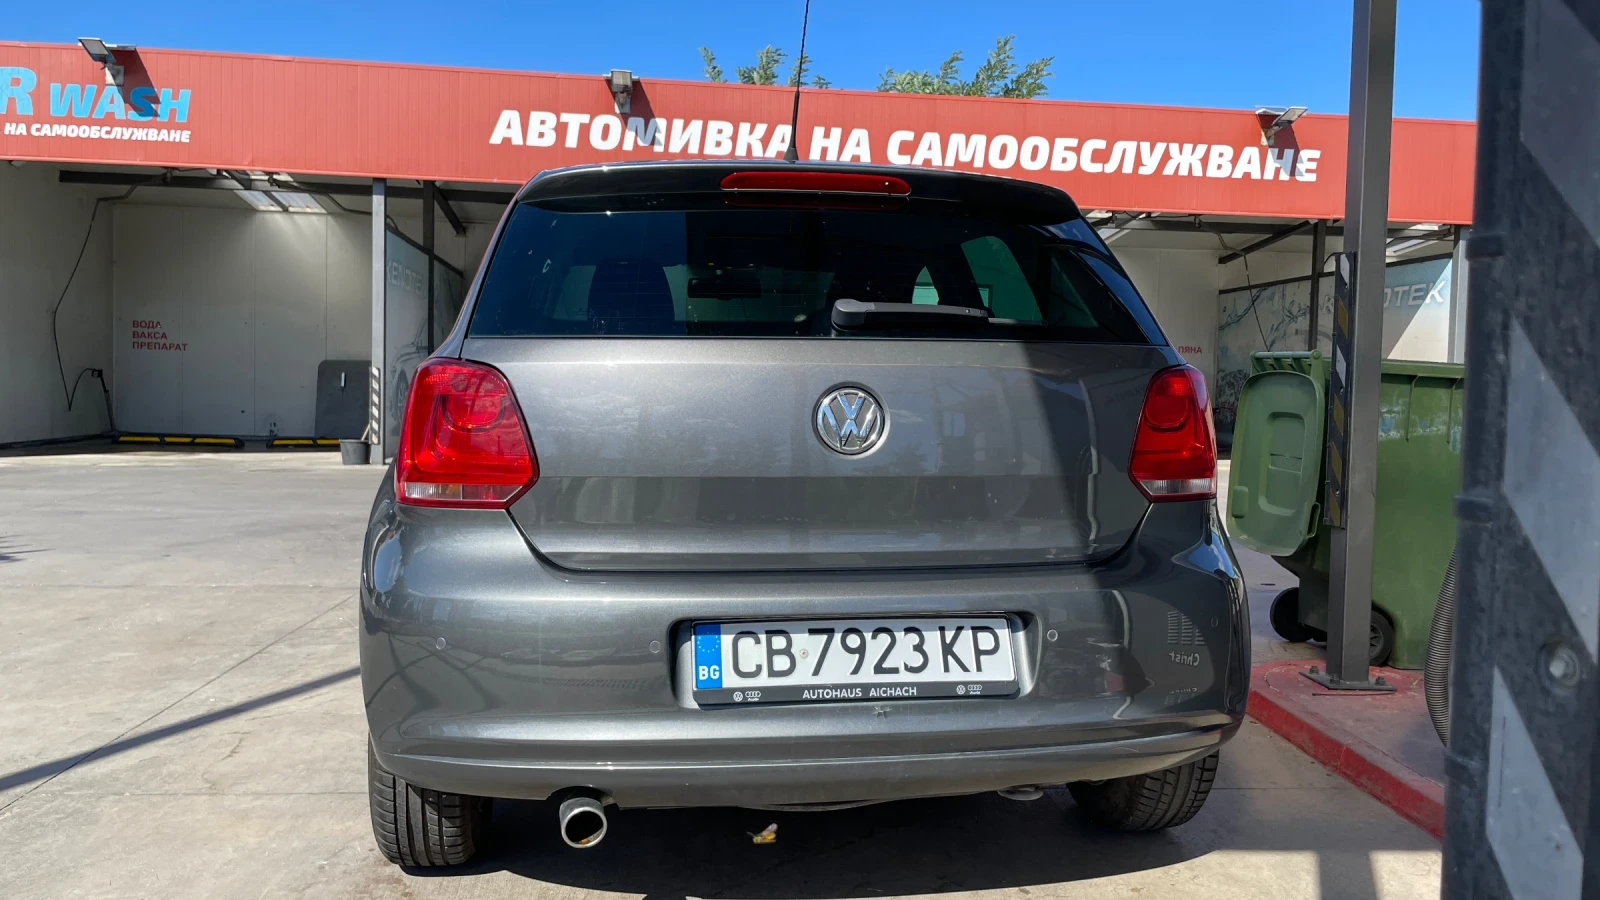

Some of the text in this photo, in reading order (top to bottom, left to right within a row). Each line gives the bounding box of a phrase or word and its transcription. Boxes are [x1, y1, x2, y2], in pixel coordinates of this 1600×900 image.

[50, 83, 192, 123] WASH
[4, 122, 192, 143] НА САМООБСЛУЖВАНЕ
[489, 109, 1322, 182] АВТОМИВКА НА САМООБСЛУЖВАНЕ
[132, 320, 162, 330] ВОДА
[132, 331, 168, 340] ВАКСА
[132, 341, 188, 351] ПРЕПАРАТ
[1178, 346, 1203, 354] ПЯНА
[807, 626, 930, 677] 7923
[698, 665, 720, 681] BG
[802, 686, 918, 699] AUTOHAUS AICHACH
